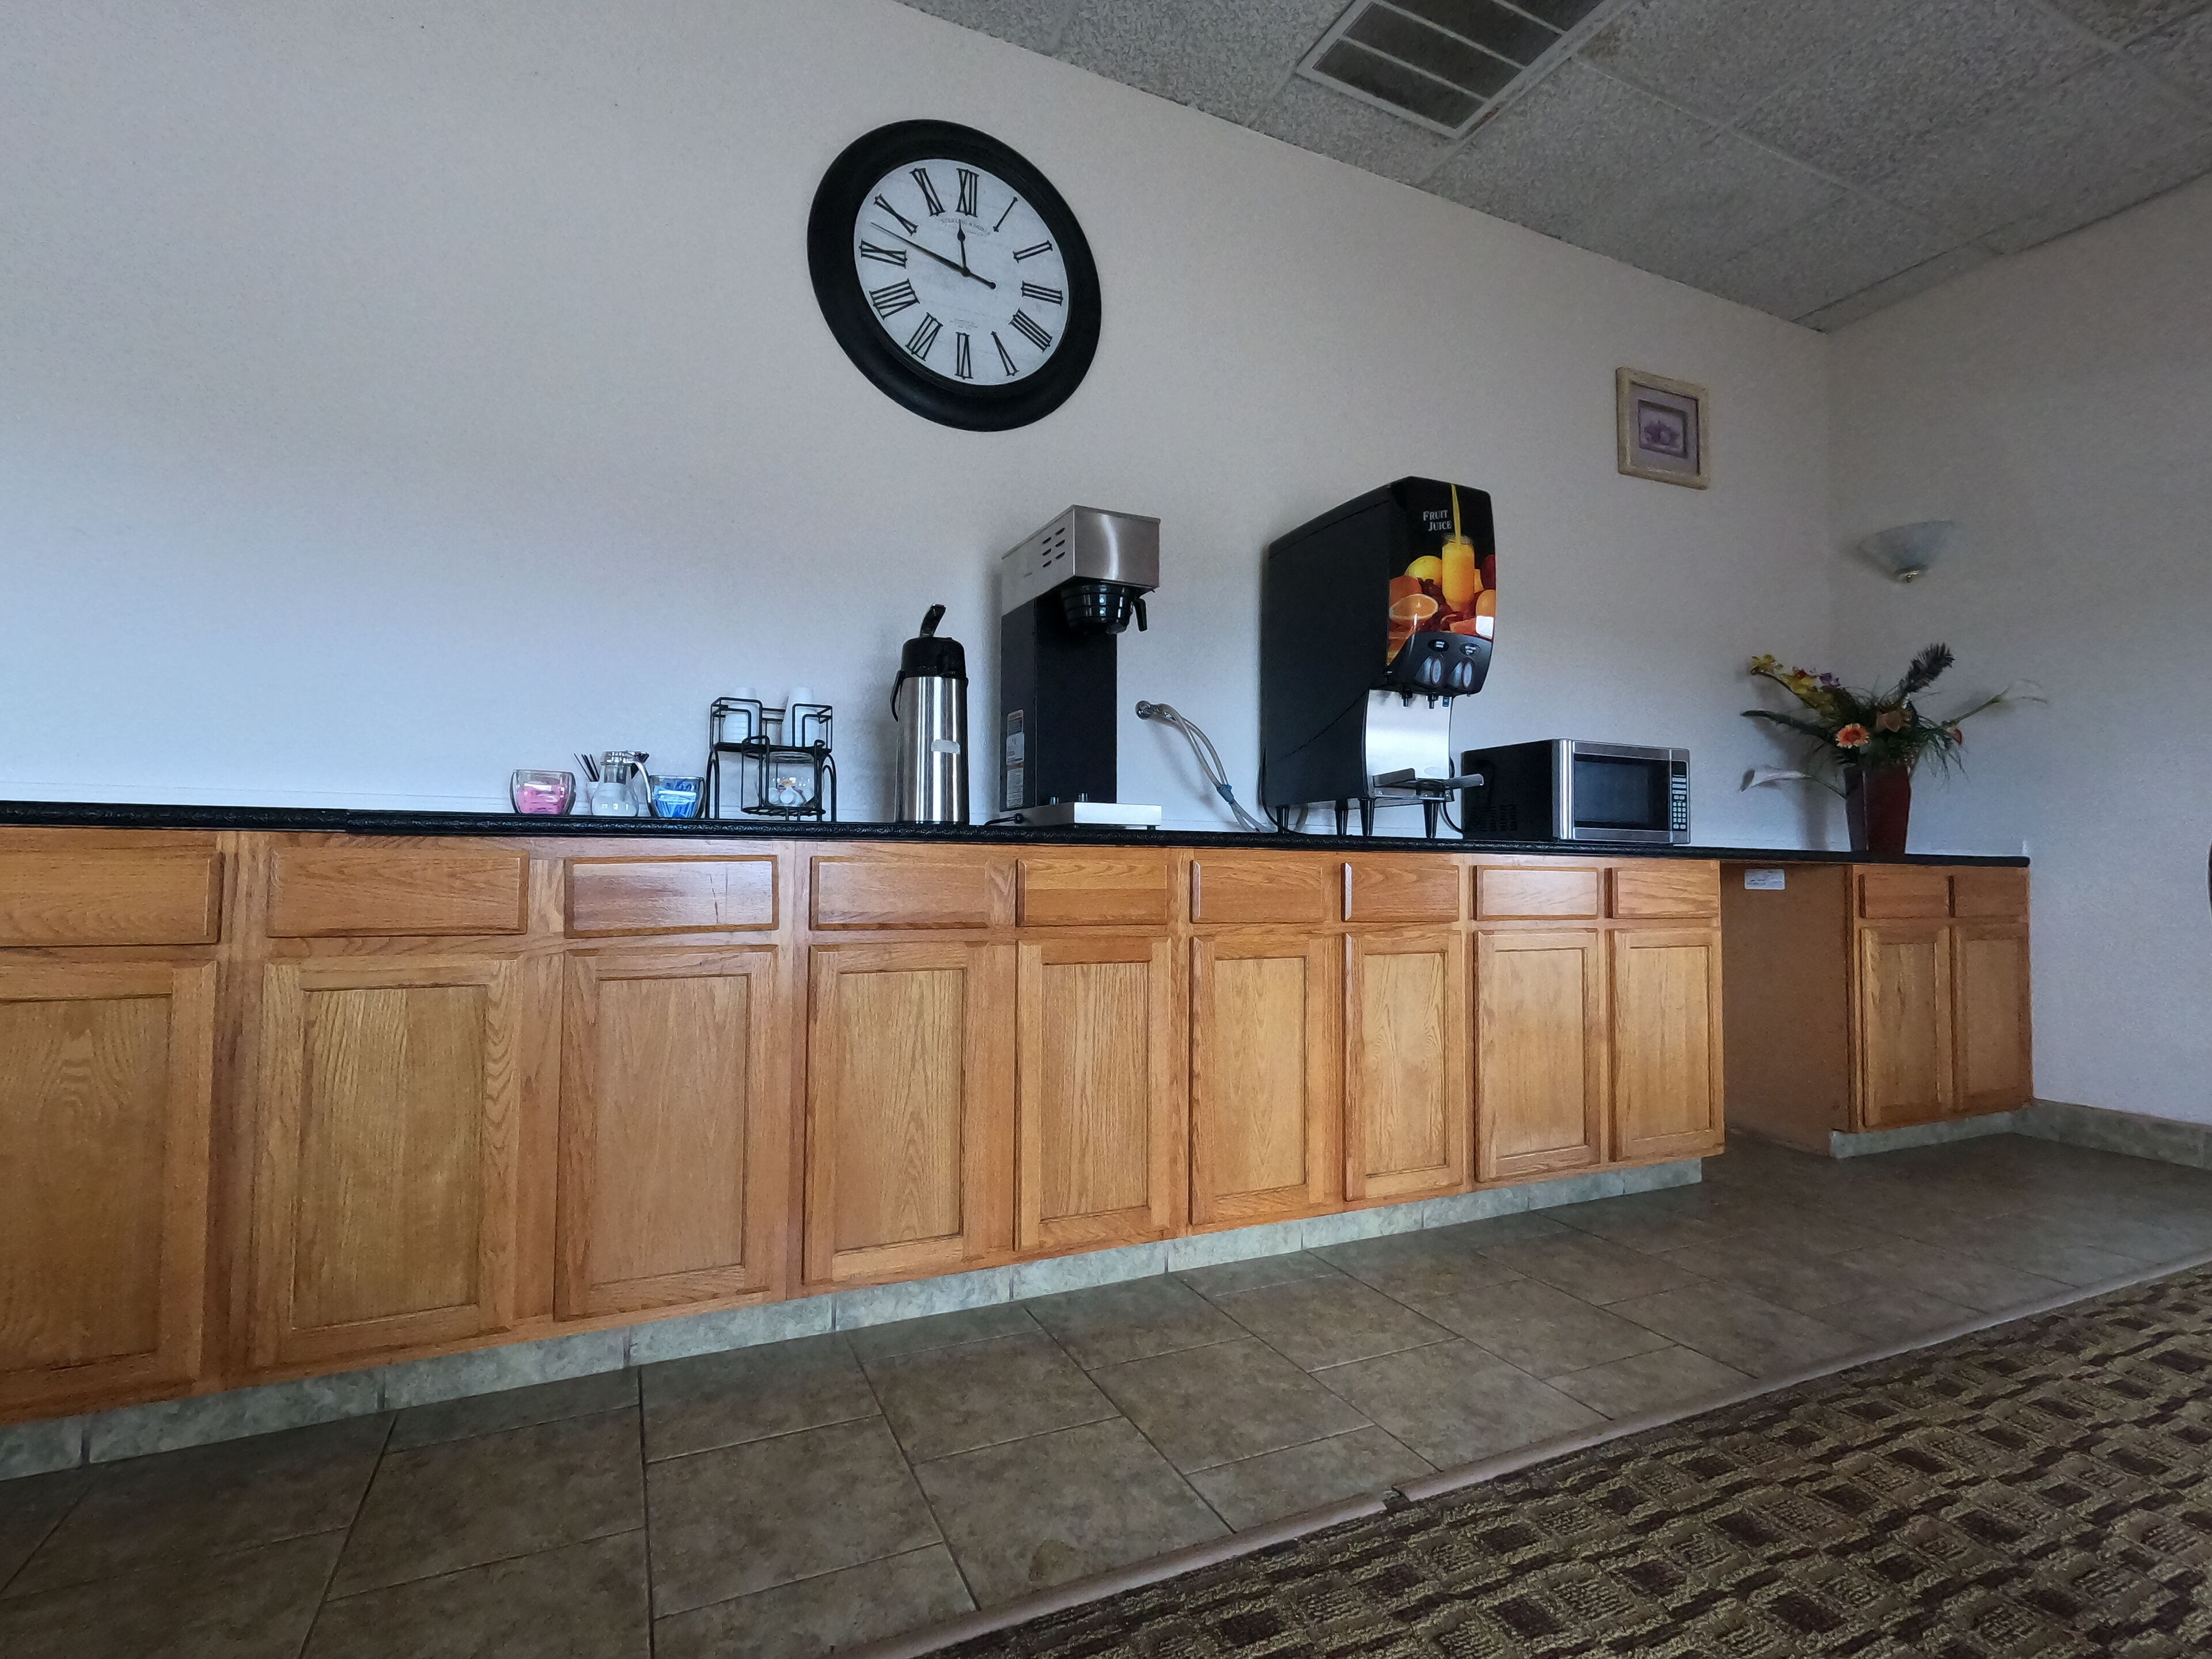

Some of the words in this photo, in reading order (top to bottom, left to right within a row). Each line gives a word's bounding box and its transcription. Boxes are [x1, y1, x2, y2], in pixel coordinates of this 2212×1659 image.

[910, 167, 946, 217] XI
[956, 168, 980, 218] XII
[873, 194, 919, 236] X
[993, 196, 1019, 233] I
[858, 238, 908, 269] IX
[1012, 240, 1053, 264] II
[869, 278, 921, 321] VIII
[1021, 281, 1064, 307] III
[905, 312, 944, 362] VII
[1008, 307, 1054, 354] IIII
[954, 331, 974, 380] VI
[990, 331, 1020, 377] V
[1423, 510, 1448, 521] FRUIT
[1428, 521, 1452, 531] JUICE
